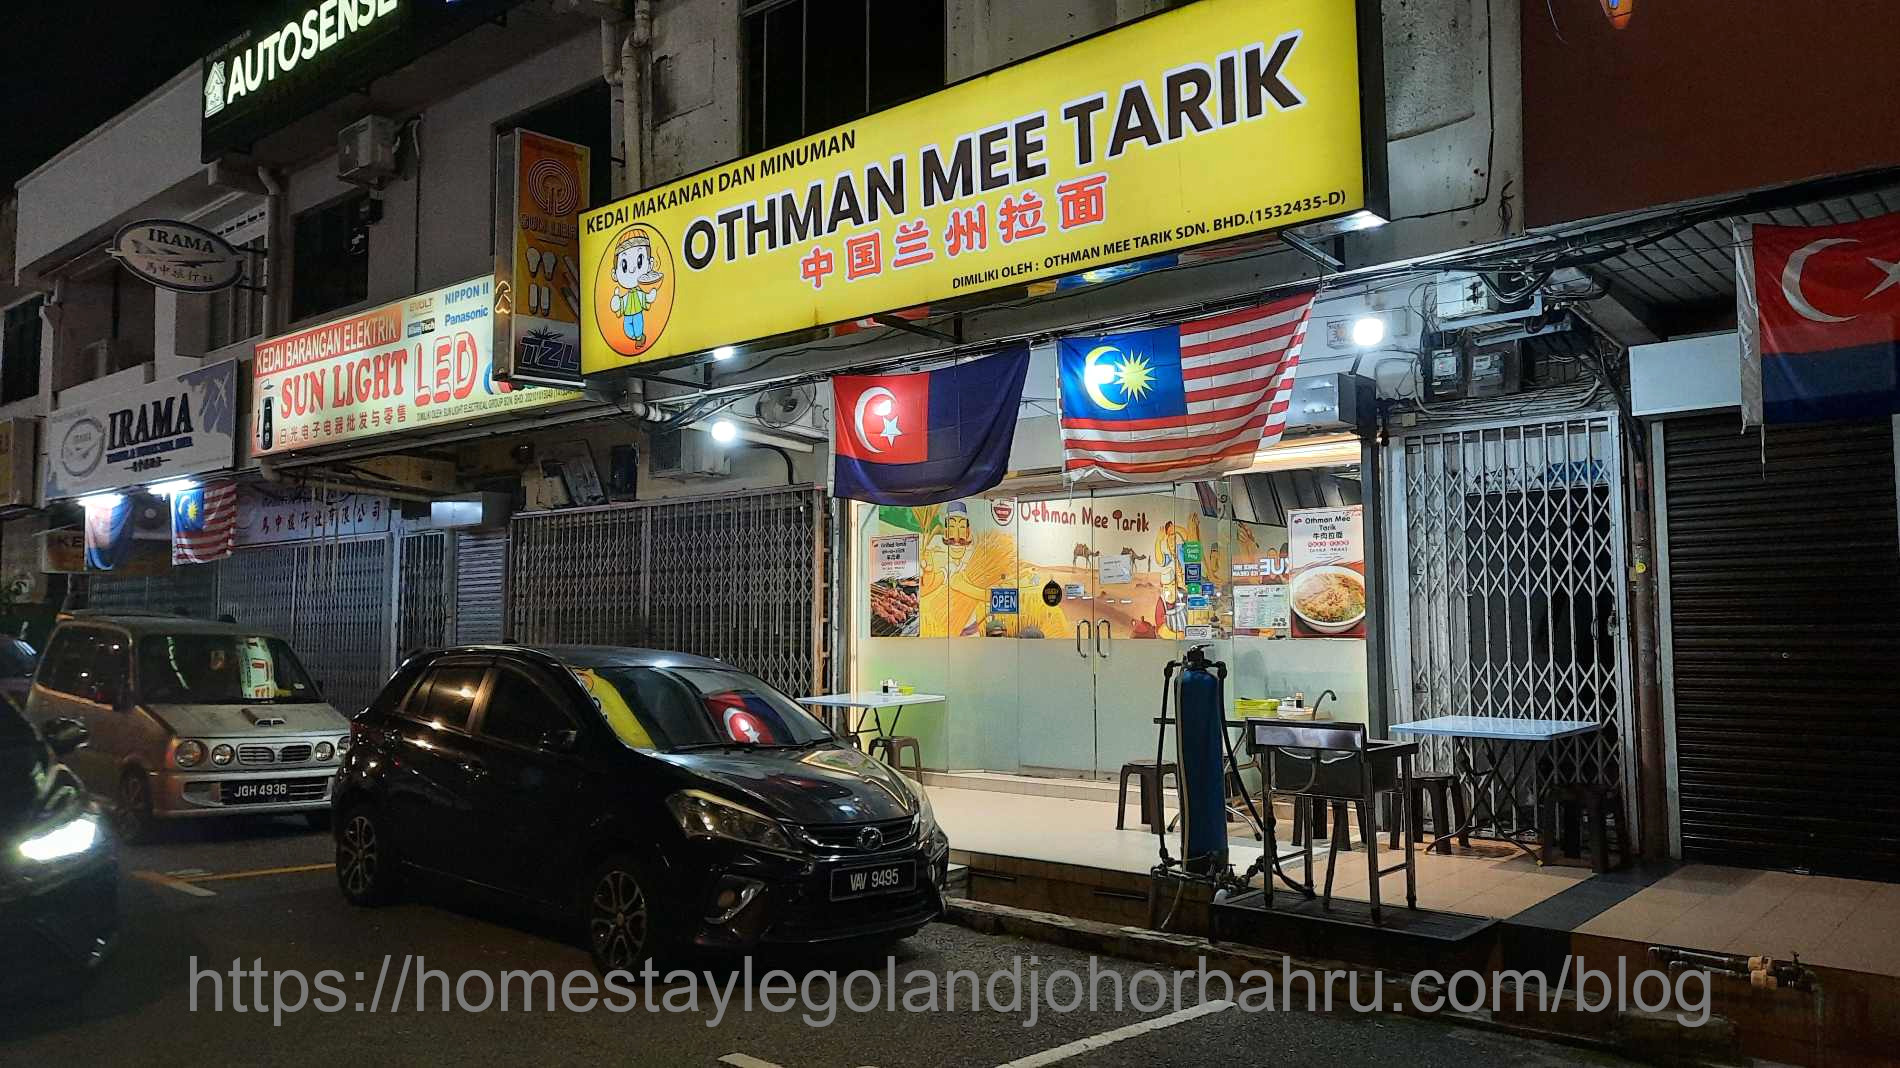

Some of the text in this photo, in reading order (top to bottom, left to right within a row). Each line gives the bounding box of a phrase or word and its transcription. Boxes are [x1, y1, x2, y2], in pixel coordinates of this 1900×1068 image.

[683, 34, 1302, 270] OTHMAN MEE TARIK
[586, 129, 856, 234] KEDAI MAKANAN DAN MINUMAN
[148, 228, 214, 253] IRAMA
[800, 175, 1107, 289] 中国兰州拉面
[952, 268, 998, 289] DIMILIKI
[1001, 260, 1033, 279] OLEH
[1043, 245, 1100, 269] OTHMAN
[1103, 238, 1131, 256] MEE
[1133, 230, 1172, 249] TARIK
[1175, 222, 1210, 239] SDN.
[444, 304, 489, 326] Panasonic
[445, 284, 480, 305] NIPPON
[255, 316, 397, 374] KEDAI BARANGAN ELEKTRIK
[280, 330, 478, 419] SUN LIGHT LED
[107, 392, 194, 451] IRAMA
[1020, 500, 1076, 525] Othman
[1081, 506, 1109, 529] Mee
[1112, 509, 1150, 533] Tarik
[992, 595, 1016, 609] OPEN
[234, 785, 257, 798] JGH
[850, 868, 899, 892] VAV 9495
